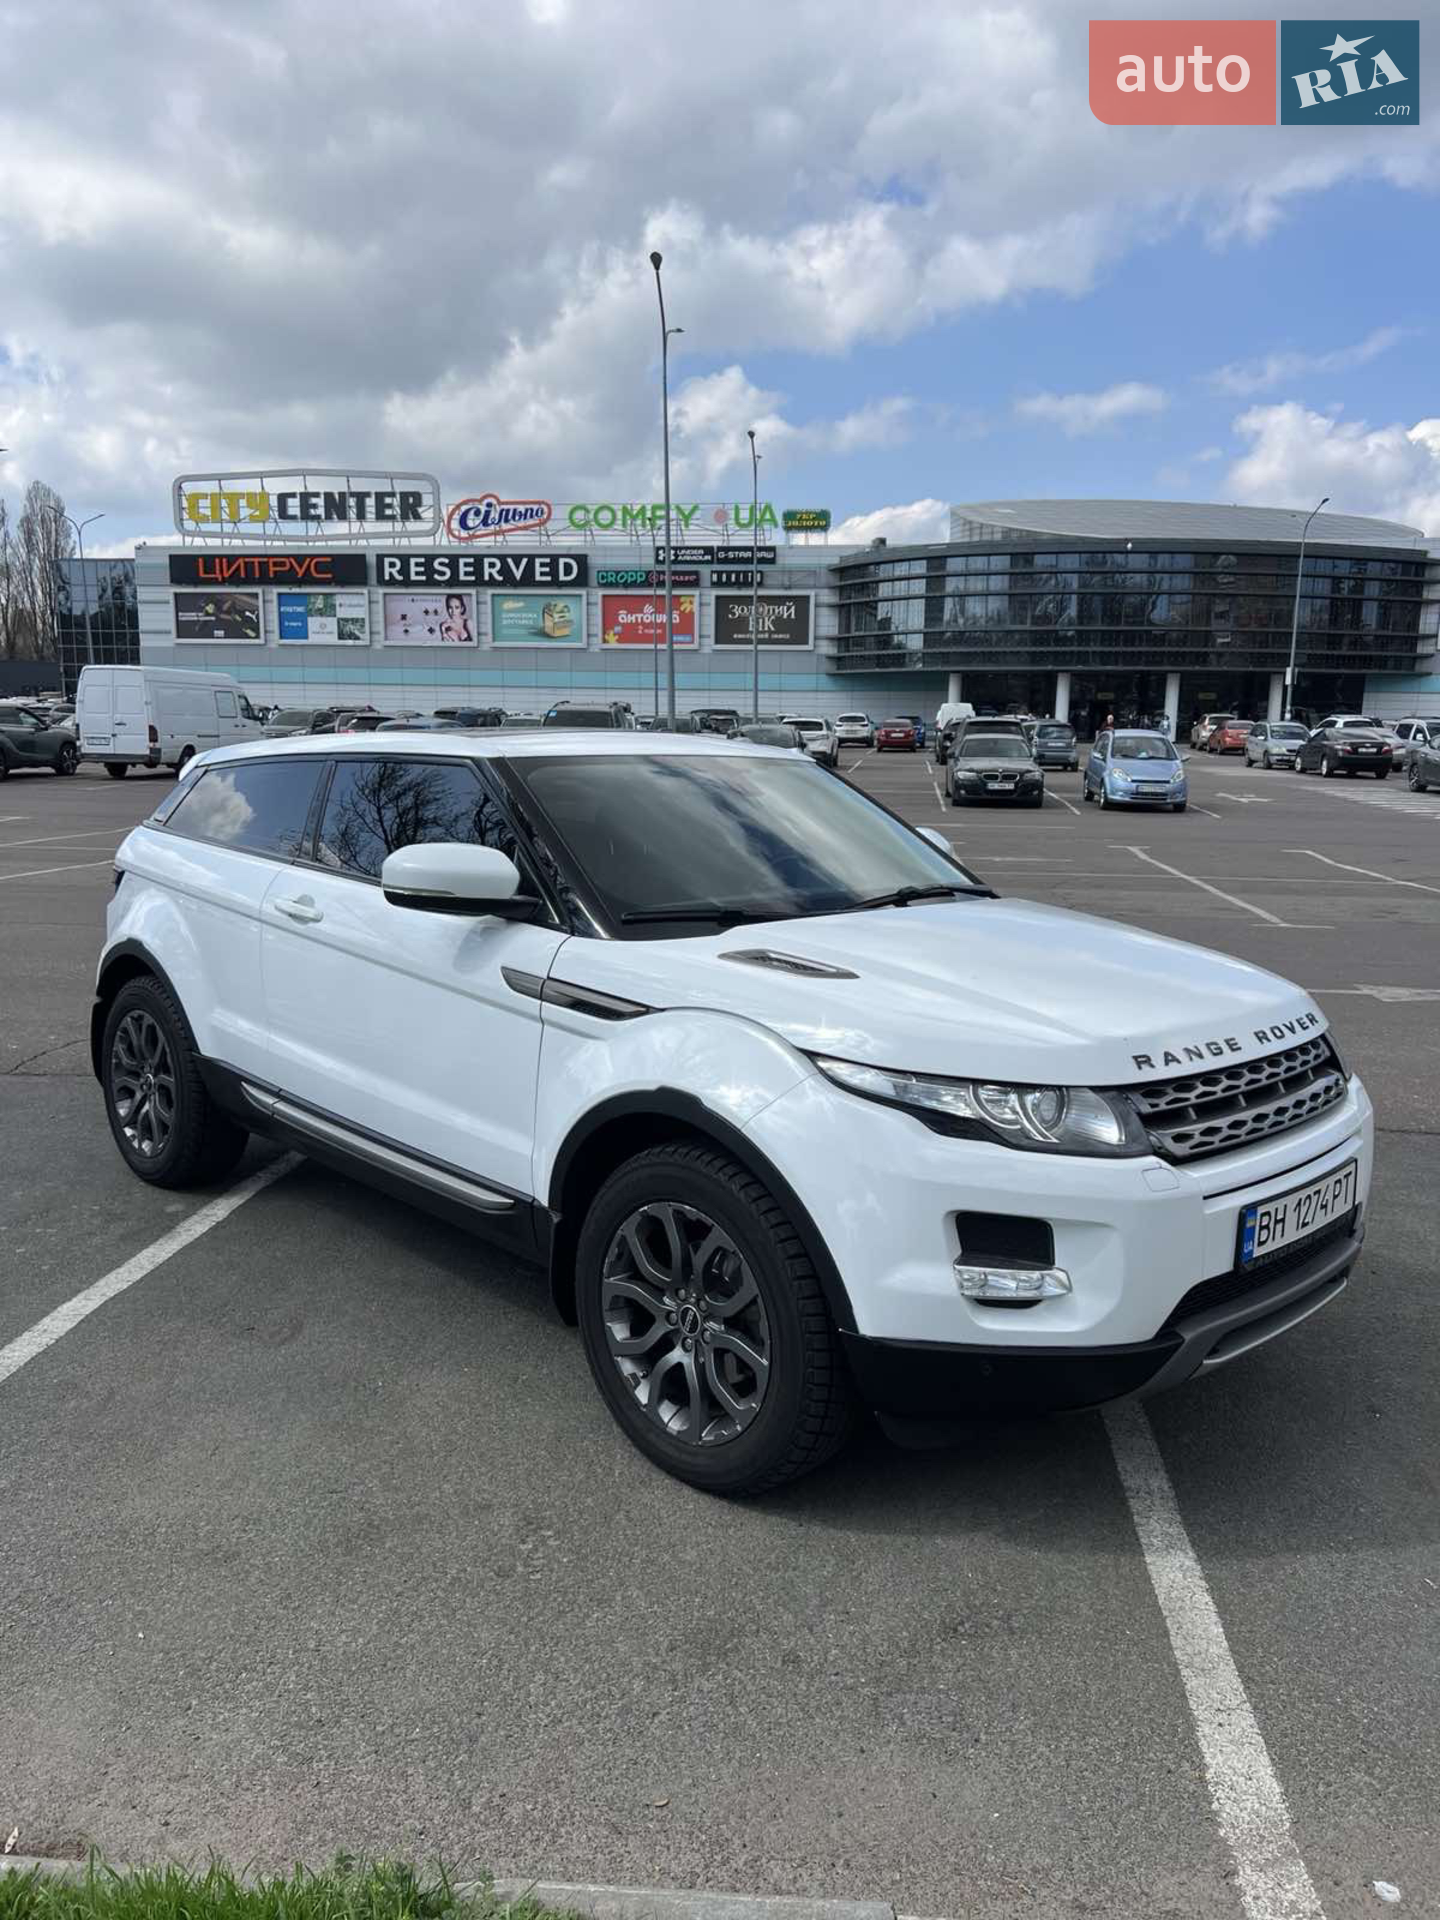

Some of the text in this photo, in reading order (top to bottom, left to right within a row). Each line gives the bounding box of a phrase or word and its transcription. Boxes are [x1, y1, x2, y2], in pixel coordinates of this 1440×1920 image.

[187, 490, 423, 524] CITY CENTER
[459, 501, 545, 531] Сільпо
[568, 502, 779, 530] COMFY UA
[198, 557, 333, 581] ЦИТРУС
[383, 557, 579, 581] RESERVED
[599, 571, 646, 584] CROPP
[1131, 1011, 1320, 1071] RANGE ROVER
[1257, 1203, 1288, 1248] BH
[1293, 1183, 1330, 1232] 1274
[1331, 1170, 1353, 1214] PT
